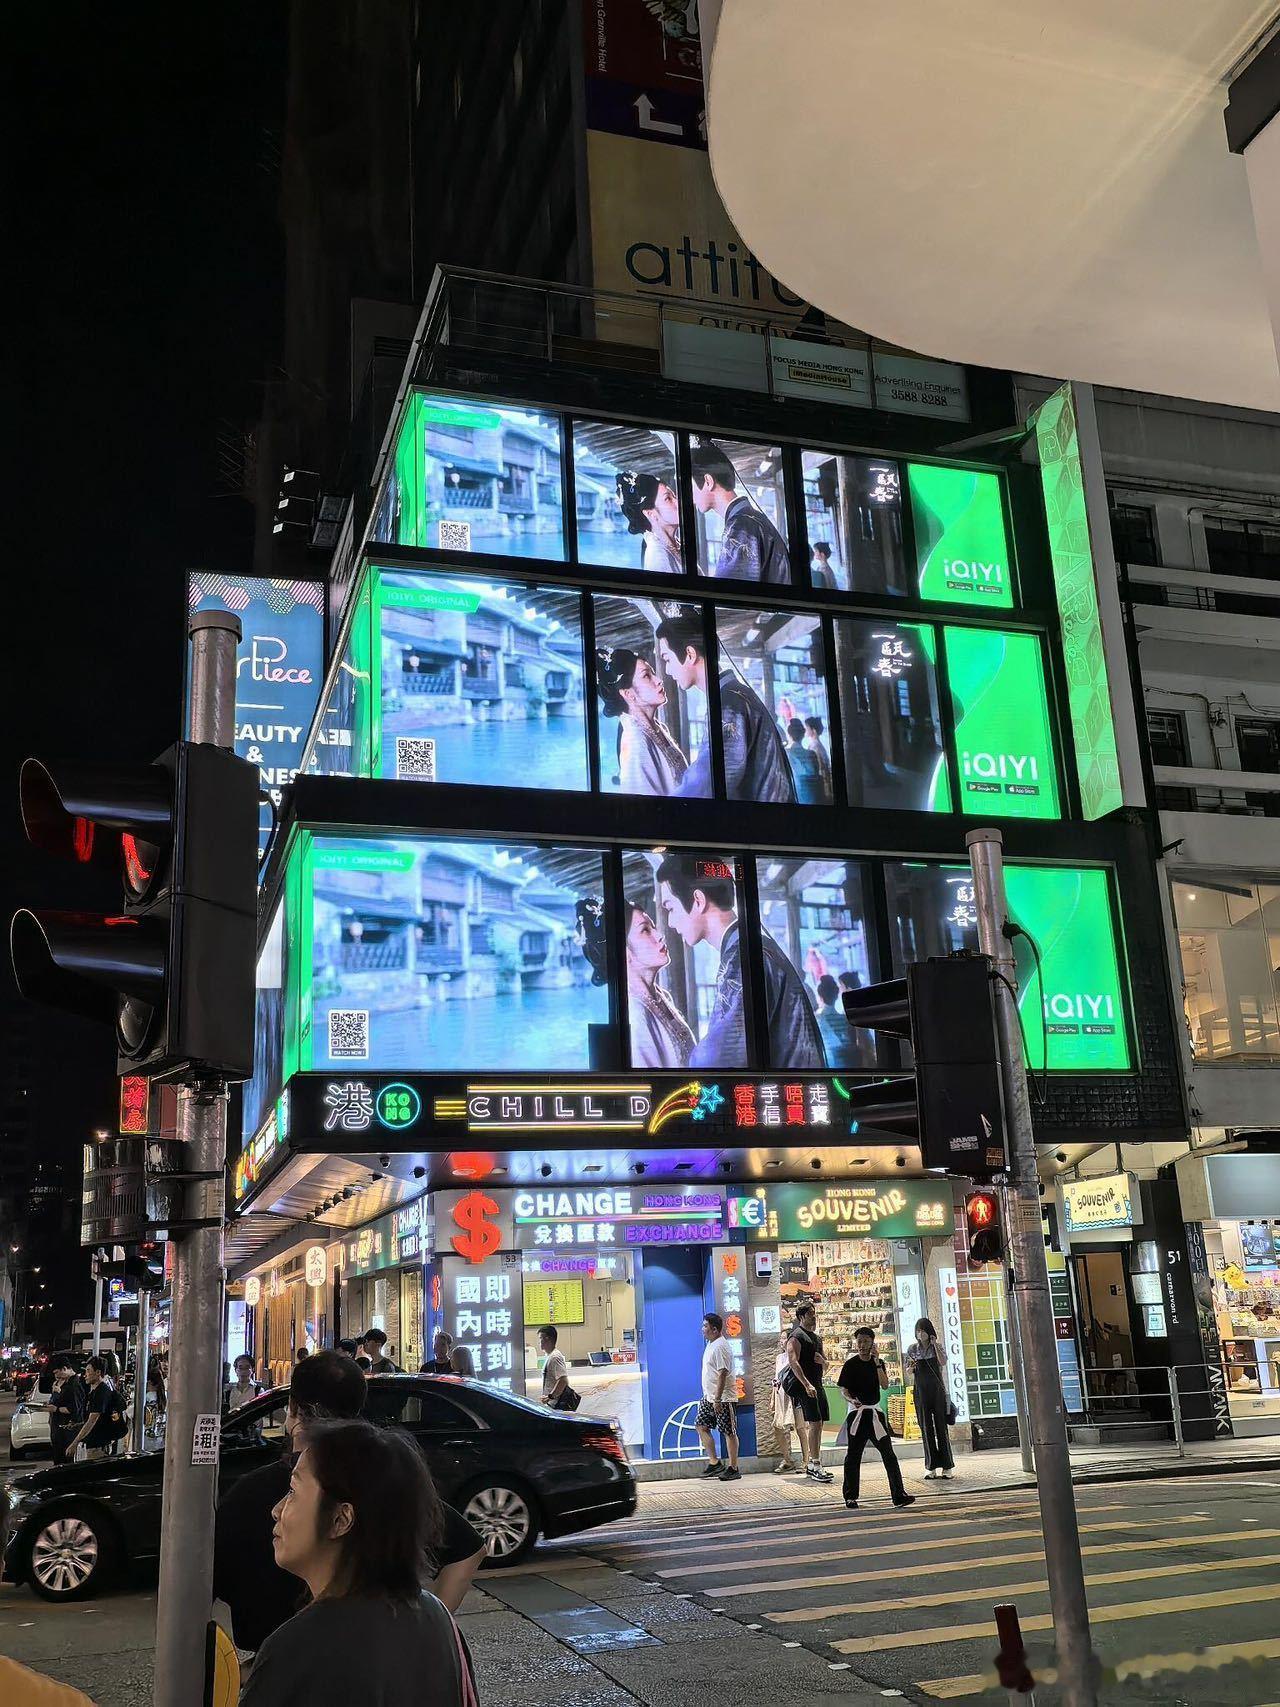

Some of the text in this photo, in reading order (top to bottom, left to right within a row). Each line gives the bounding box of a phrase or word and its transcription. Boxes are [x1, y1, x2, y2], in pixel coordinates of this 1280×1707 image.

[773, 356, 865, 376] FOCUS MEDIA HONG KONG
[875, 374, 961, 395] Advertising Enquiries
[891, 389, 948, 407] 3588 8288
[944, 559, 1003, 582] iQIYI
[236, 635, 312, 684] rtPiece
[235, 724, 303, 743] EAUTY
[246, 746, 264, 763] &
[963, 751, 1038, 781] iQIYI
[324, 1082, 374, 1130] 港
[643, 1193, 722, 1208] HONG KONG
[825, 1187, 876, 1198] HONG KONG
[1077, 1187, 1116, 1210] SOUVENIR
[514, 1192, 633, 1217] CHANGE
[797, 1189, 907, 1229] SOUVENIR
[624, 1223, 723, 1243] EXCHANGE
[837, 1224, 871, 1232] LIMITED
[505, 1254, 517, 1263] 53
[541, 1257, 596, 1272] CHANGE
[1167, 1250, 1181, 1265] 51
[1166, 1272, 1180, 1324] carnarvon rd
[946, 1273, 967, 1417] I HONG KONG
[200, 1433, 213, 1449] 租
